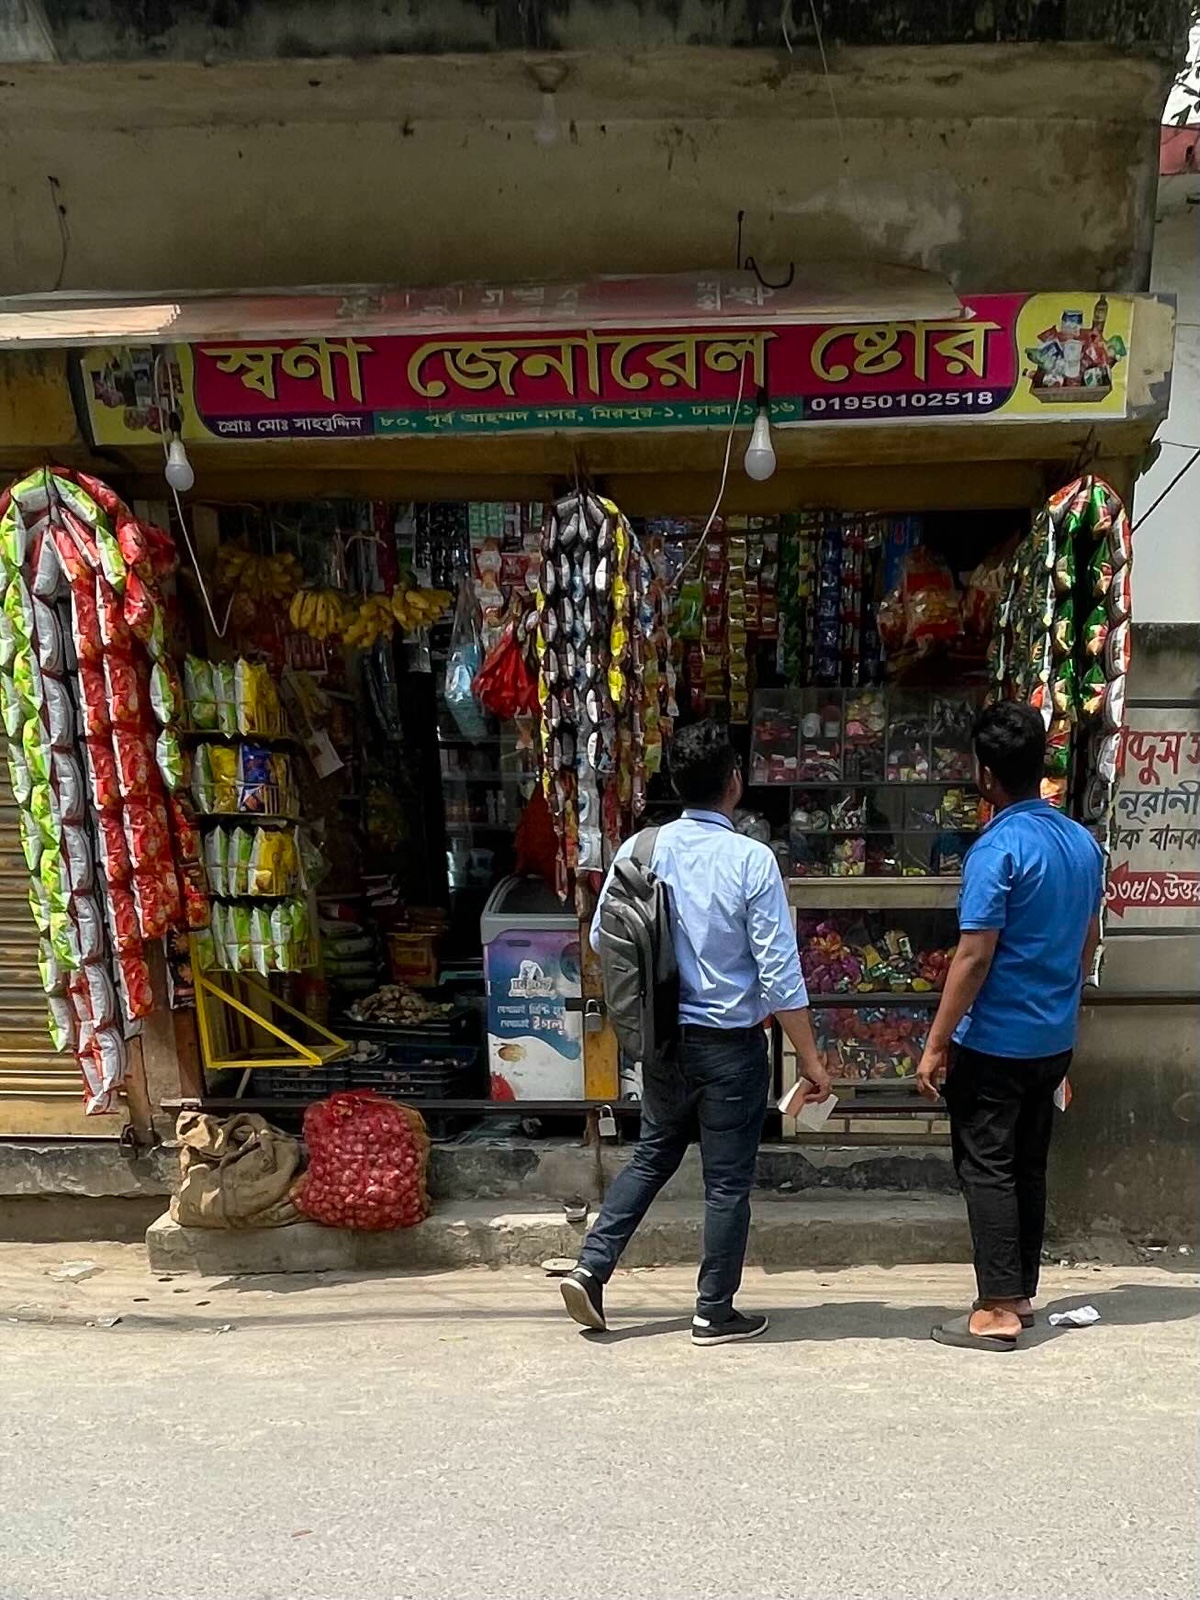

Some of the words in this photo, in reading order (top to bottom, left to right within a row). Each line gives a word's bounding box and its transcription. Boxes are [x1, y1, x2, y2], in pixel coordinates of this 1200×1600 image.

[406, 327, 779, 400] জেনারেল
[690, 400, 796, 418] ঢাকা-১১৬
[811, 390, 994, 412] 01950102518
